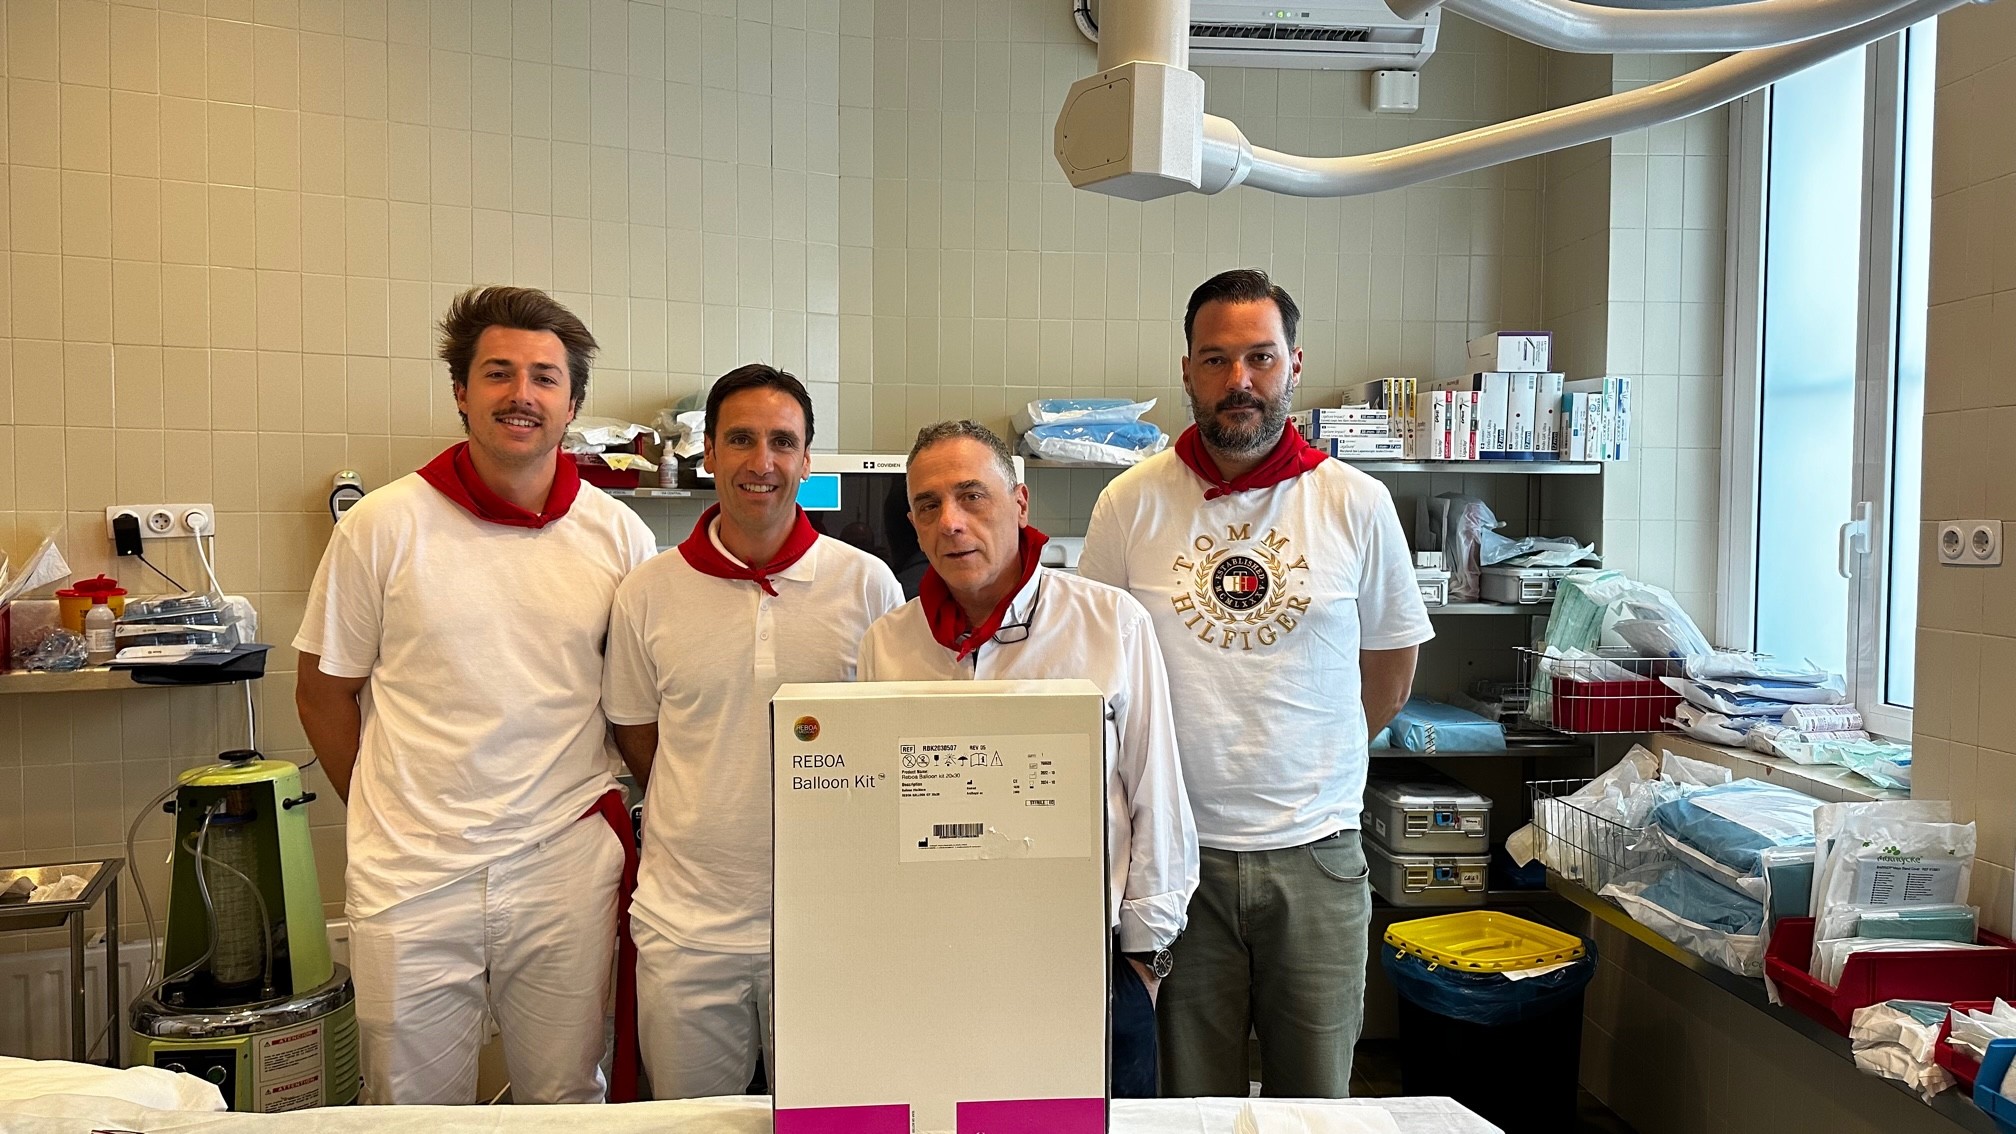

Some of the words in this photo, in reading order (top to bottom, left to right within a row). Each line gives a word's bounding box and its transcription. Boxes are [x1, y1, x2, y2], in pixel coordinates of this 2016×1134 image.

[1172, 523, 1310, 572] TOMMY
[1216, 558, 1266, 580] ESTABLISHED
[1171, 592, 1312, 650] HILFIGER
[792, 754, 845, 768] REBOA
[793, 776, 849, 789] Balloon
[855, 775, 875, 788] Kit
[278, 1077, 315, 1092] ATTENTION
